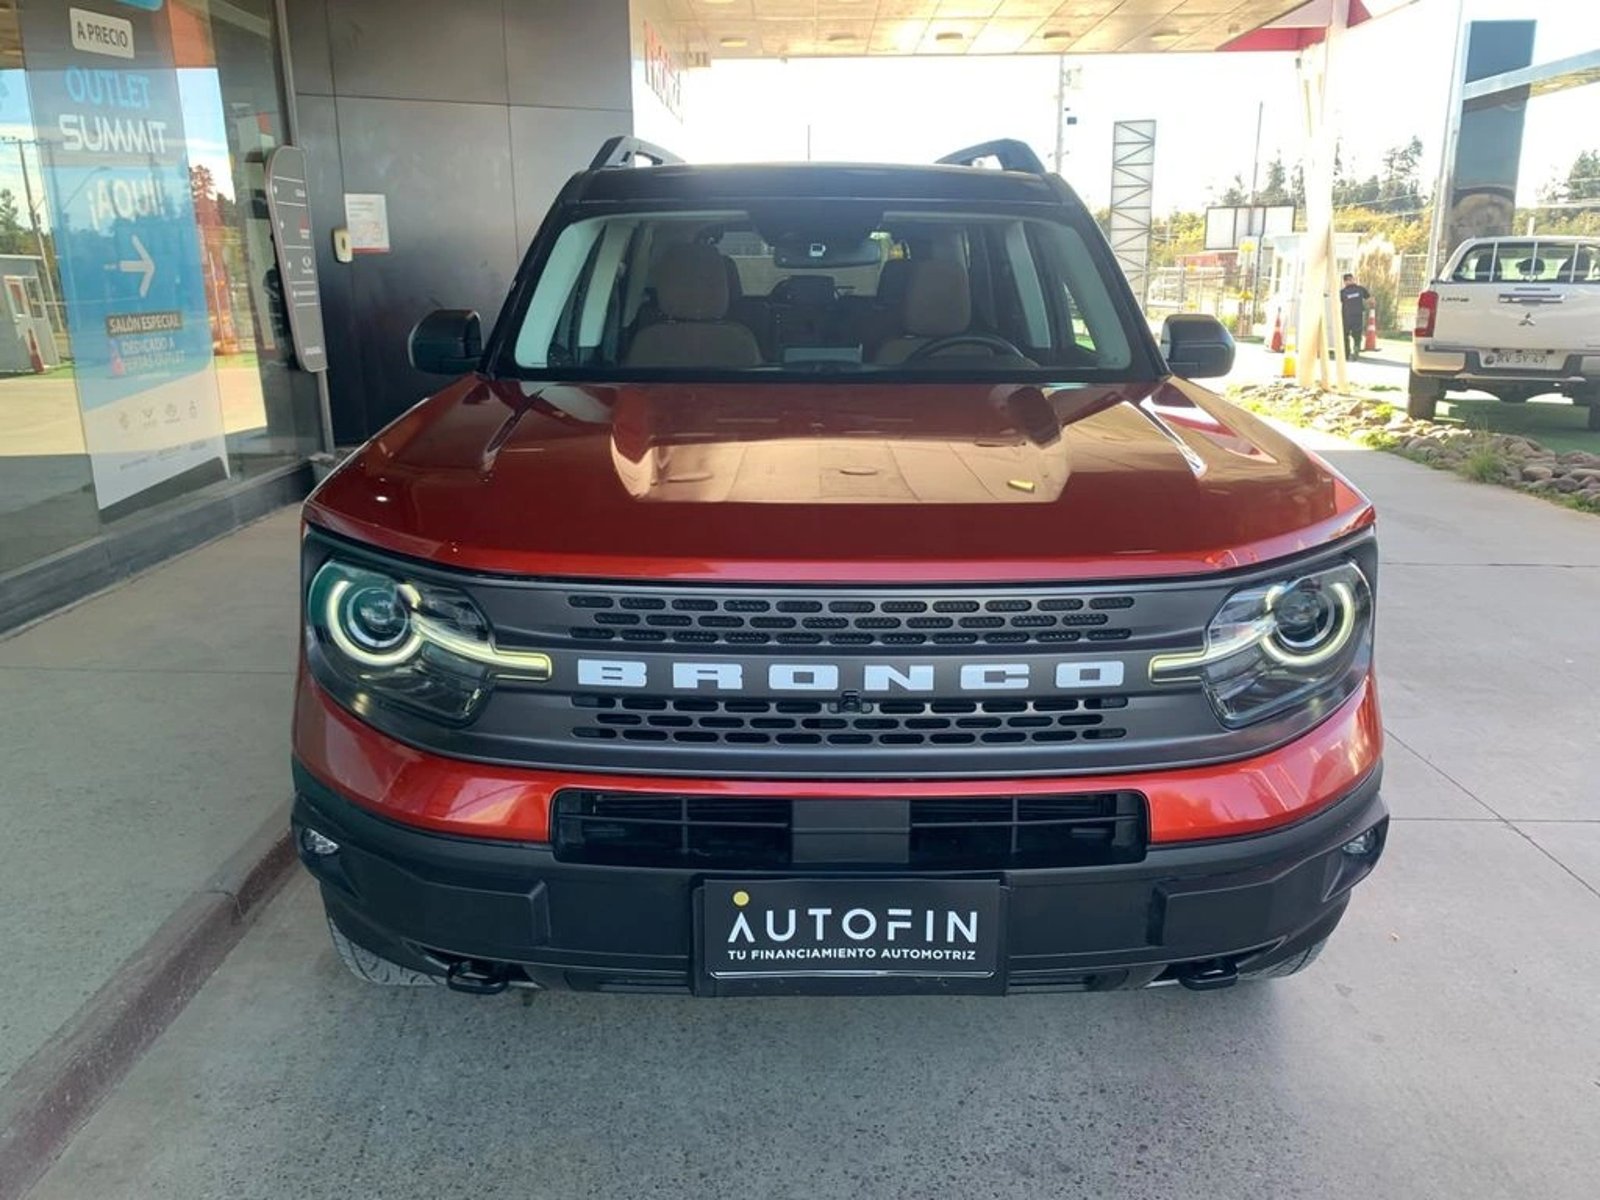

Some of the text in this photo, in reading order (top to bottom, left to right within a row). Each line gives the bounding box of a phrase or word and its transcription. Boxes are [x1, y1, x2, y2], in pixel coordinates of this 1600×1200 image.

[77, 21, 128, 48] A PRECIO
[64, 66, 149, 107] OUTLET
[59, 114, 167, 153] SUMMIT
[577, 659, 1124, 691] BRONCO
[727, 908, 978, 944] AUTOFIN
[727, 948, 976, 961] TU FINANCIAMIENTO AUTOMOTRIZ
